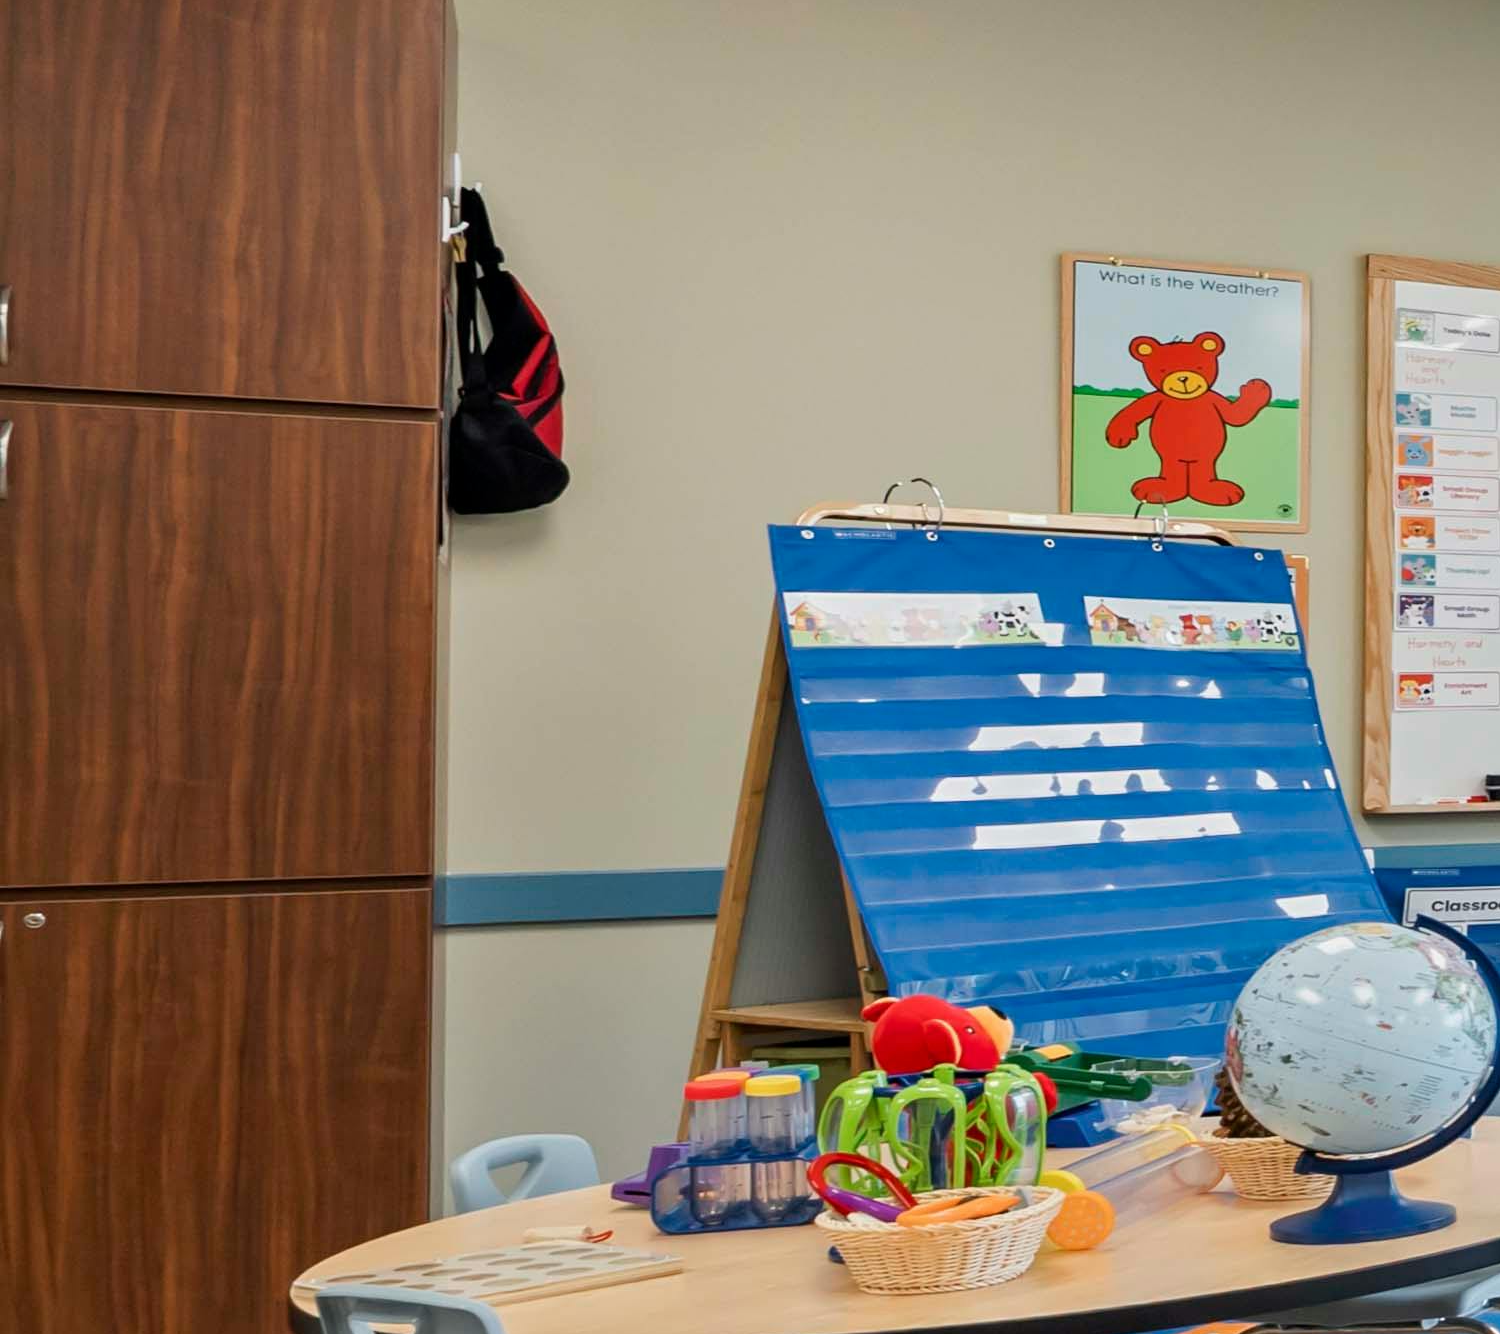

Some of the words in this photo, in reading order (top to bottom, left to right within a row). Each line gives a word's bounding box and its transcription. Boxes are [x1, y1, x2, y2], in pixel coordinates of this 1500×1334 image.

[1099, 270, 1145, 286] What
[1151, 274, 1162, 287] is
[1167, 277, 1194, 290] the
[1199, 279, 1279, 298] Weather?
